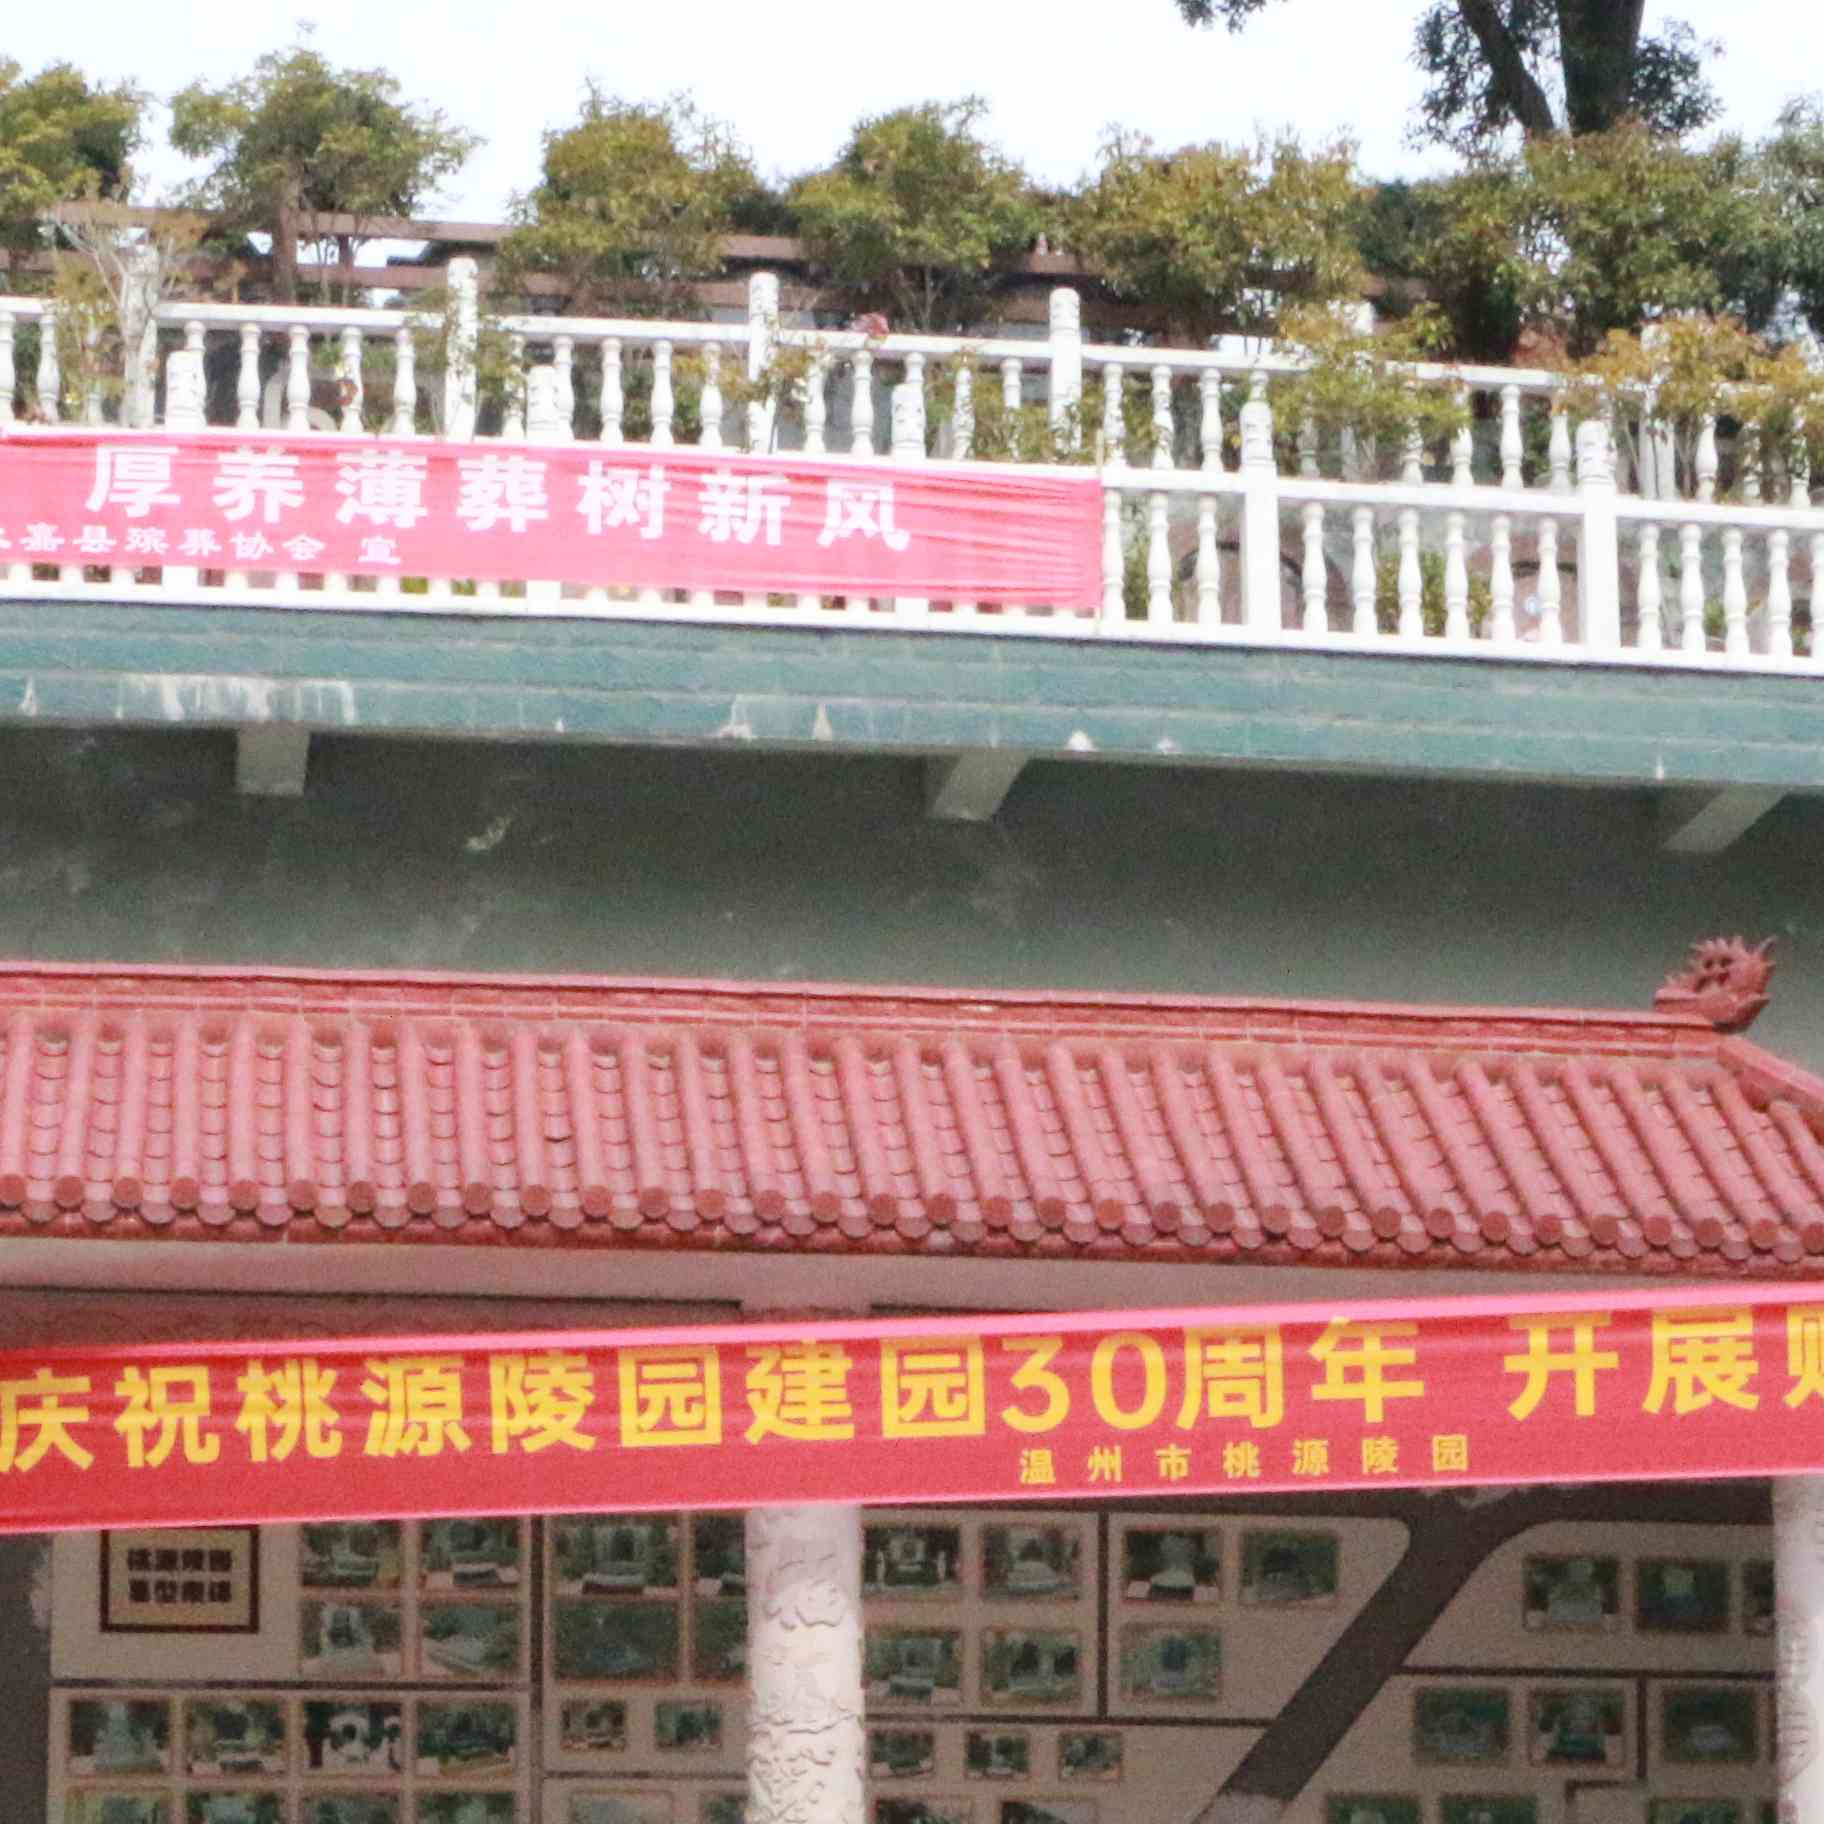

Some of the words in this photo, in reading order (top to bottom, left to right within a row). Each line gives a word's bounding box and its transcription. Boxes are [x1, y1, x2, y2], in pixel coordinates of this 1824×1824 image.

[84, 445, 912, 552] 厚养薄葬树新风
[357, 536, 402, 565] 宣
[1018, 1433, 1471, 1486] 温州市桃源陵园
